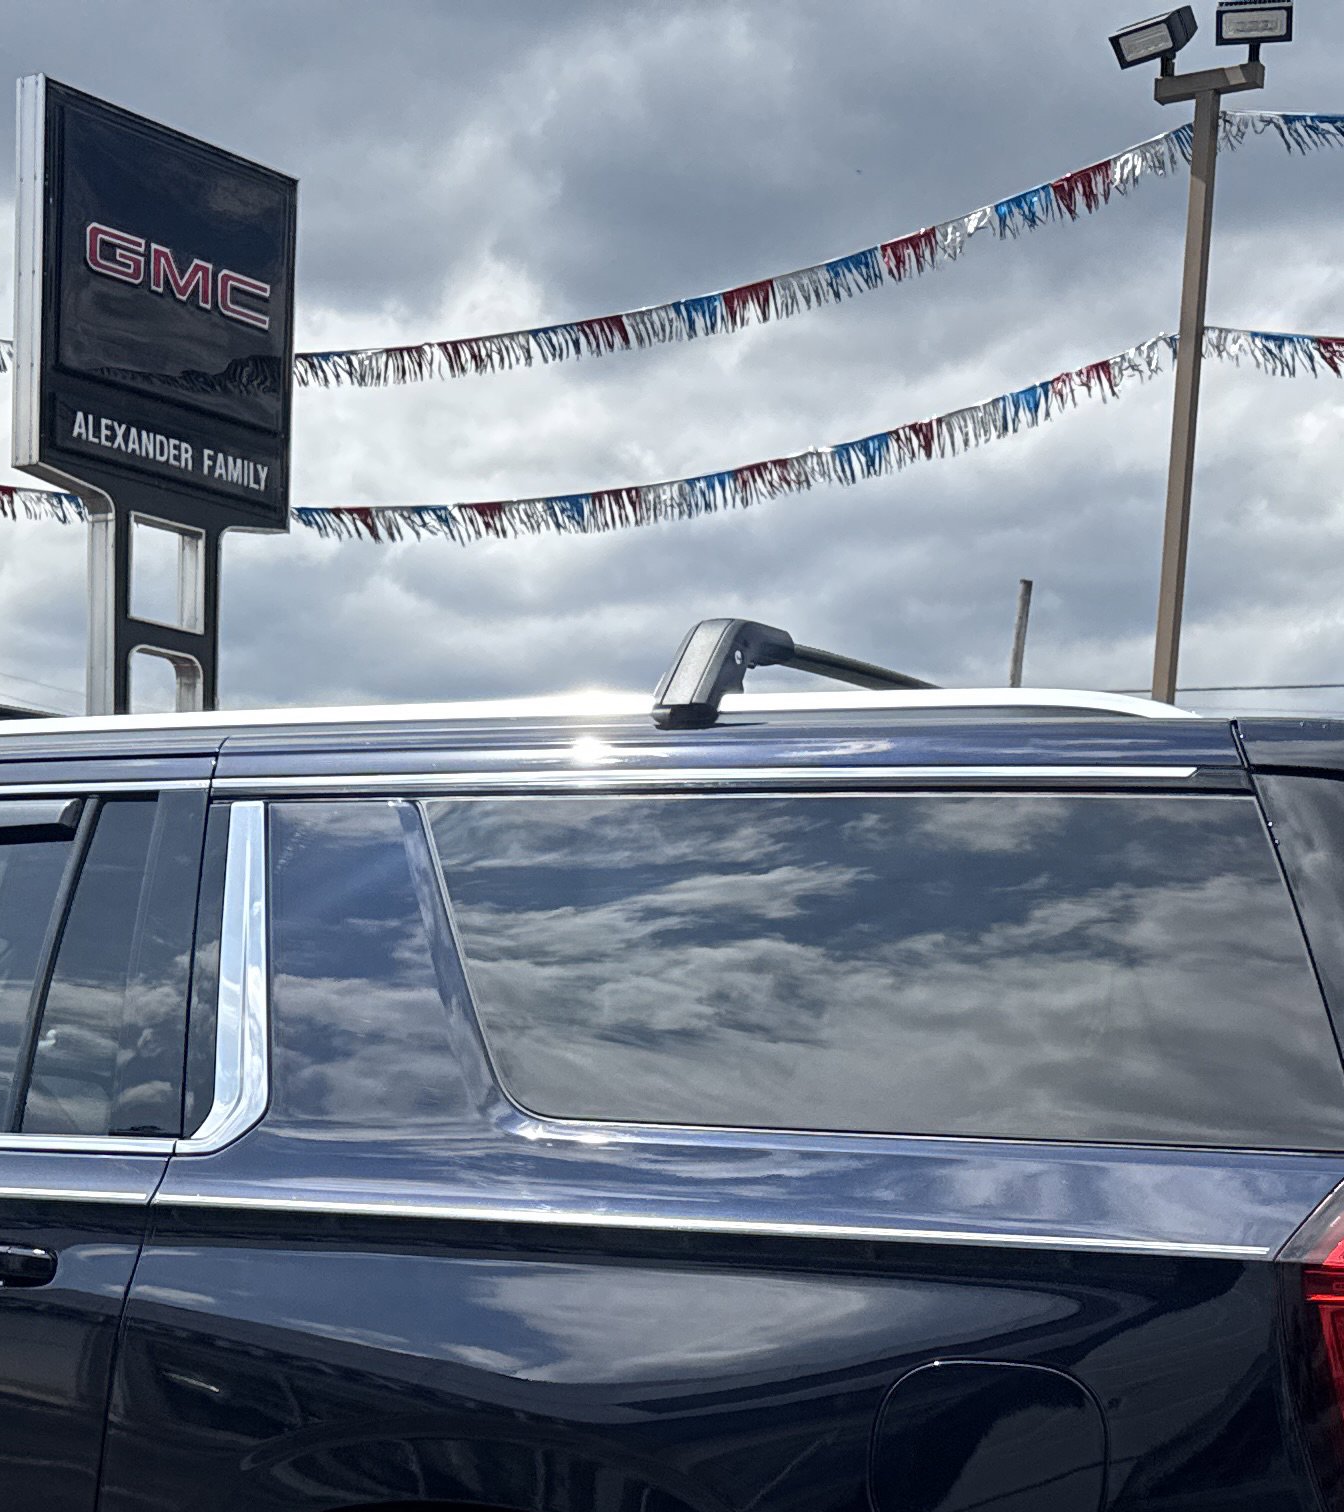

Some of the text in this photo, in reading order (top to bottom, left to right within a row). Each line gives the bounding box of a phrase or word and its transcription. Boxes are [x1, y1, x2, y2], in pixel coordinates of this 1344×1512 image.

[86, 222, 271, 331] GMC
[72, 410, 269, 492] ALEXANDER FAMILY
